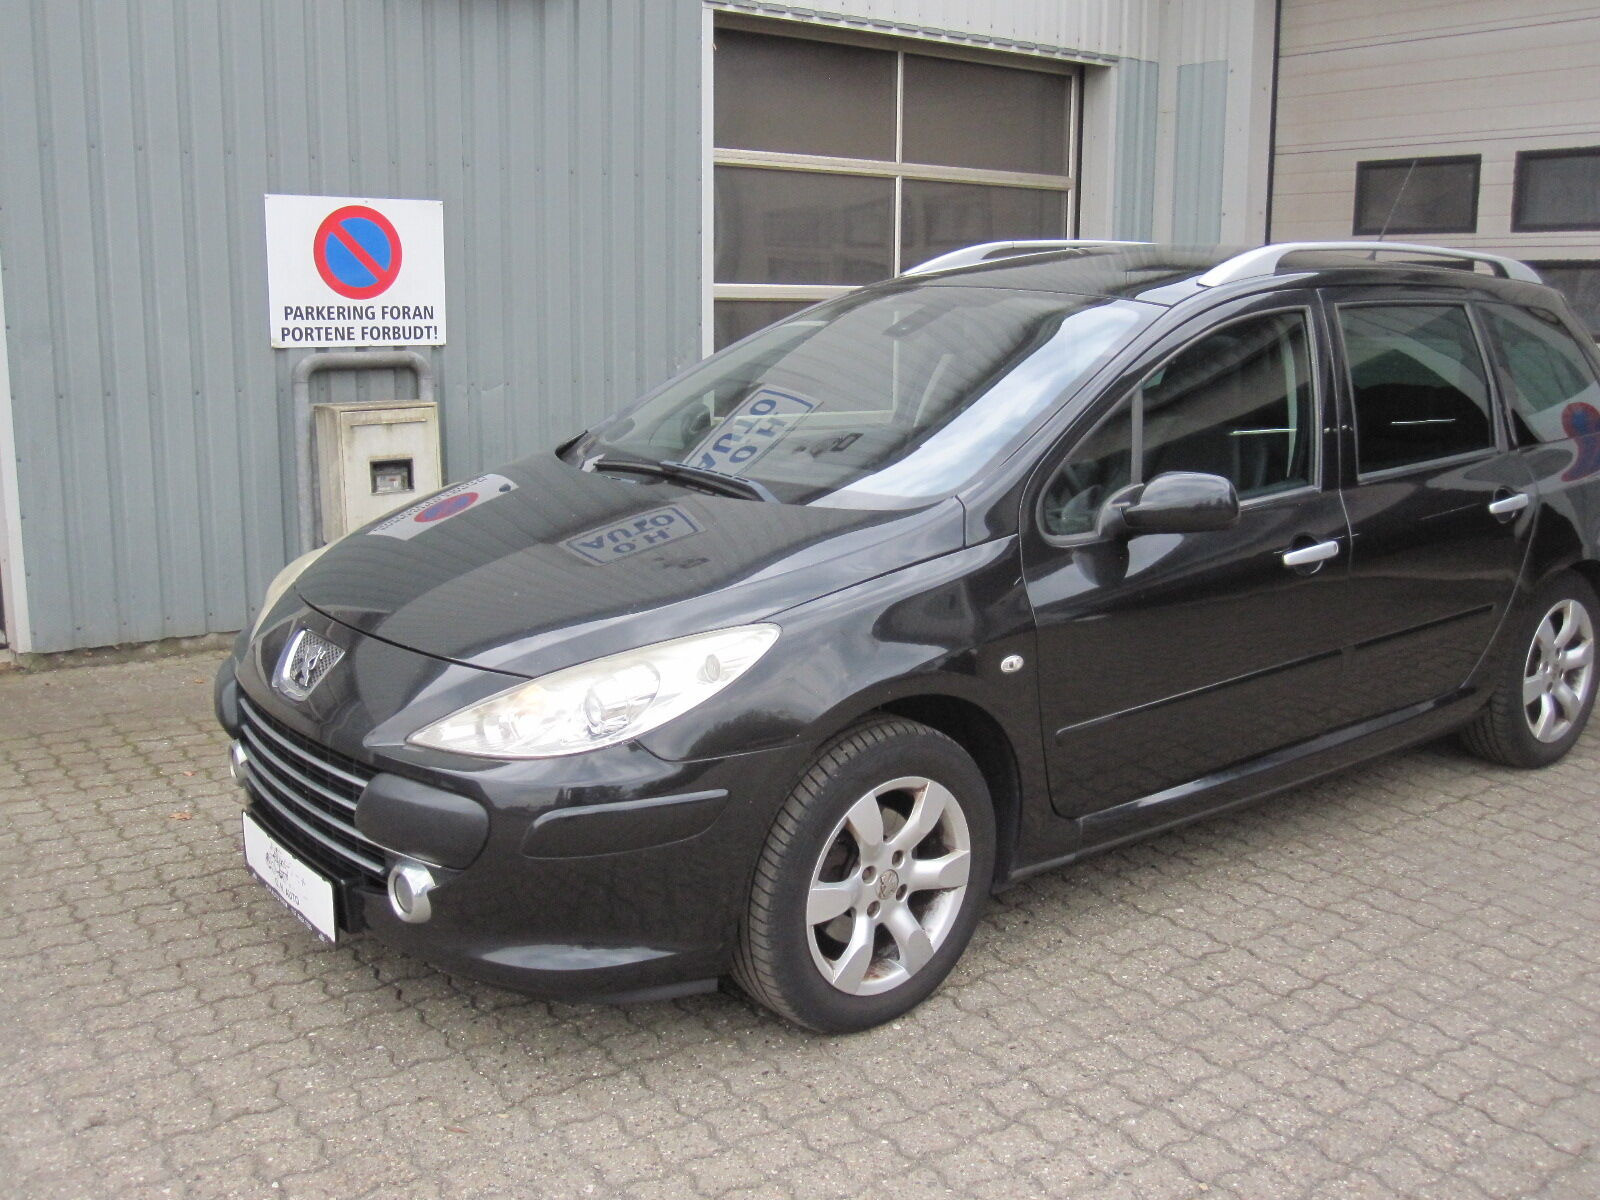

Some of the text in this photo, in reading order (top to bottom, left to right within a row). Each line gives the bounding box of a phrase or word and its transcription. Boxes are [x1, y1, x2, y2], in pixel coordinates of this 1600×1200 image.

[284, 305, 434, 321] PARKERING FORAN
[281, 325, 438, 342] PORTENE FORBUDT!
